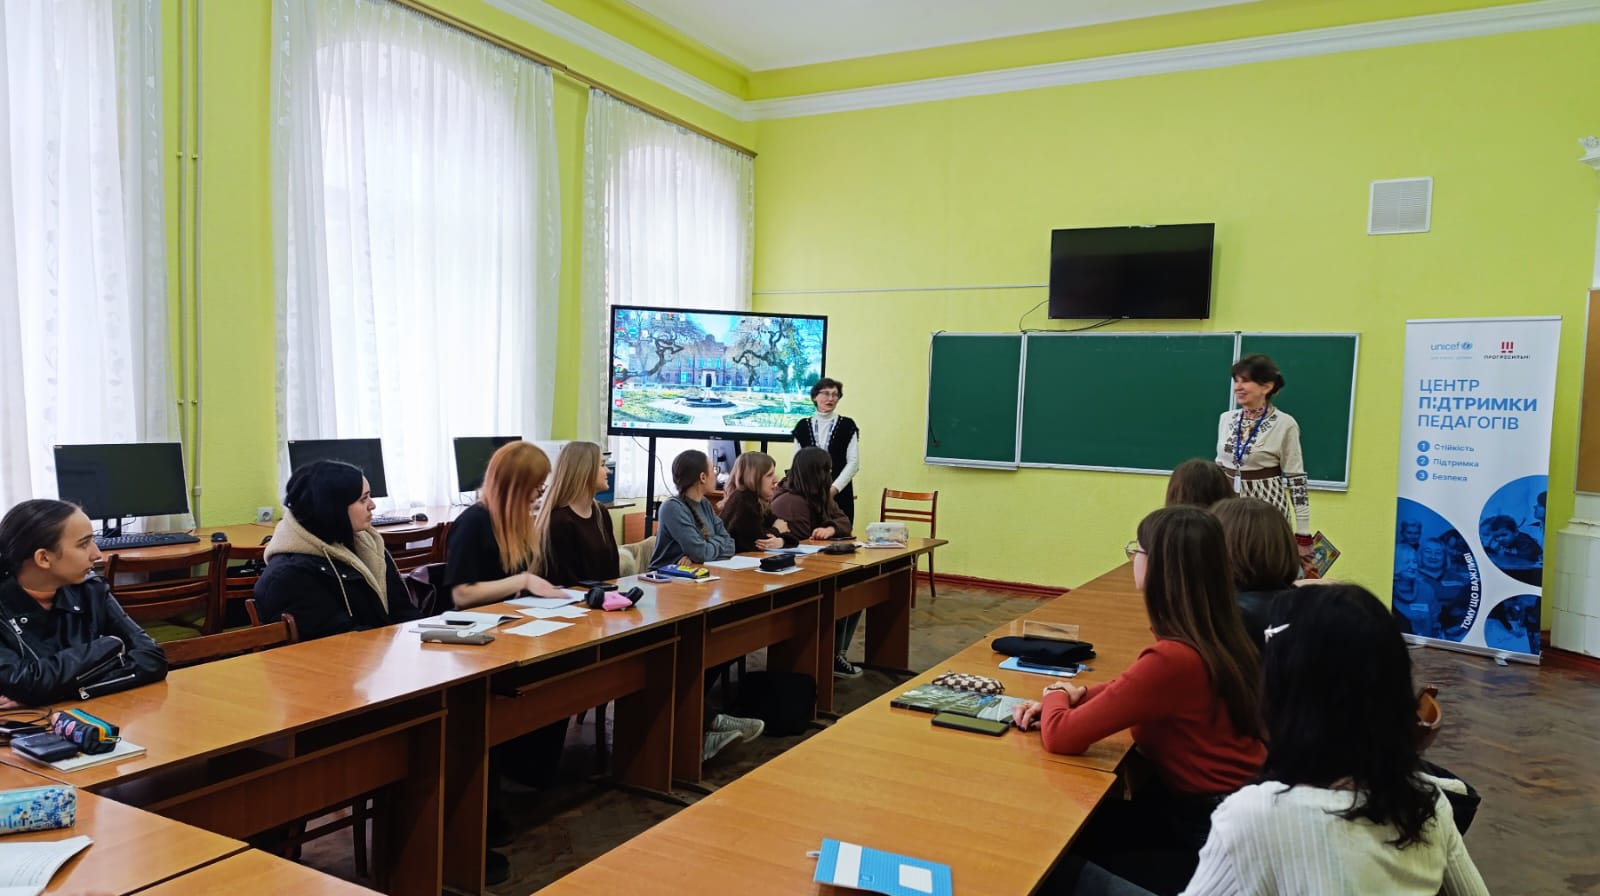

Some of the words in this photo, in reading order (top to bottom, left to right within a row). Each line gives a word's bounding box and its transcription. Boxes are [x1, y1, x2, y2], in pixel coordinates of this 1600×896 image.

[1430, 341, 1460, 351] unicef
[1419, 379, 1480, 394] ЦЕНТР
[1418, 414, 1519, 430] ПЕДАГОГІВ
[1434, 443, 1475, 452] Стійкість
[1433, 458, 1479, 468] Підтримка
[1432, 473, 1468, 482] Безпека
[1463, 552, 1479, 591] ВАЖЛИВІ
[1469, 592, 1480, 608] ЩО
[1460, 607, 1476, 629] ТОМУ
